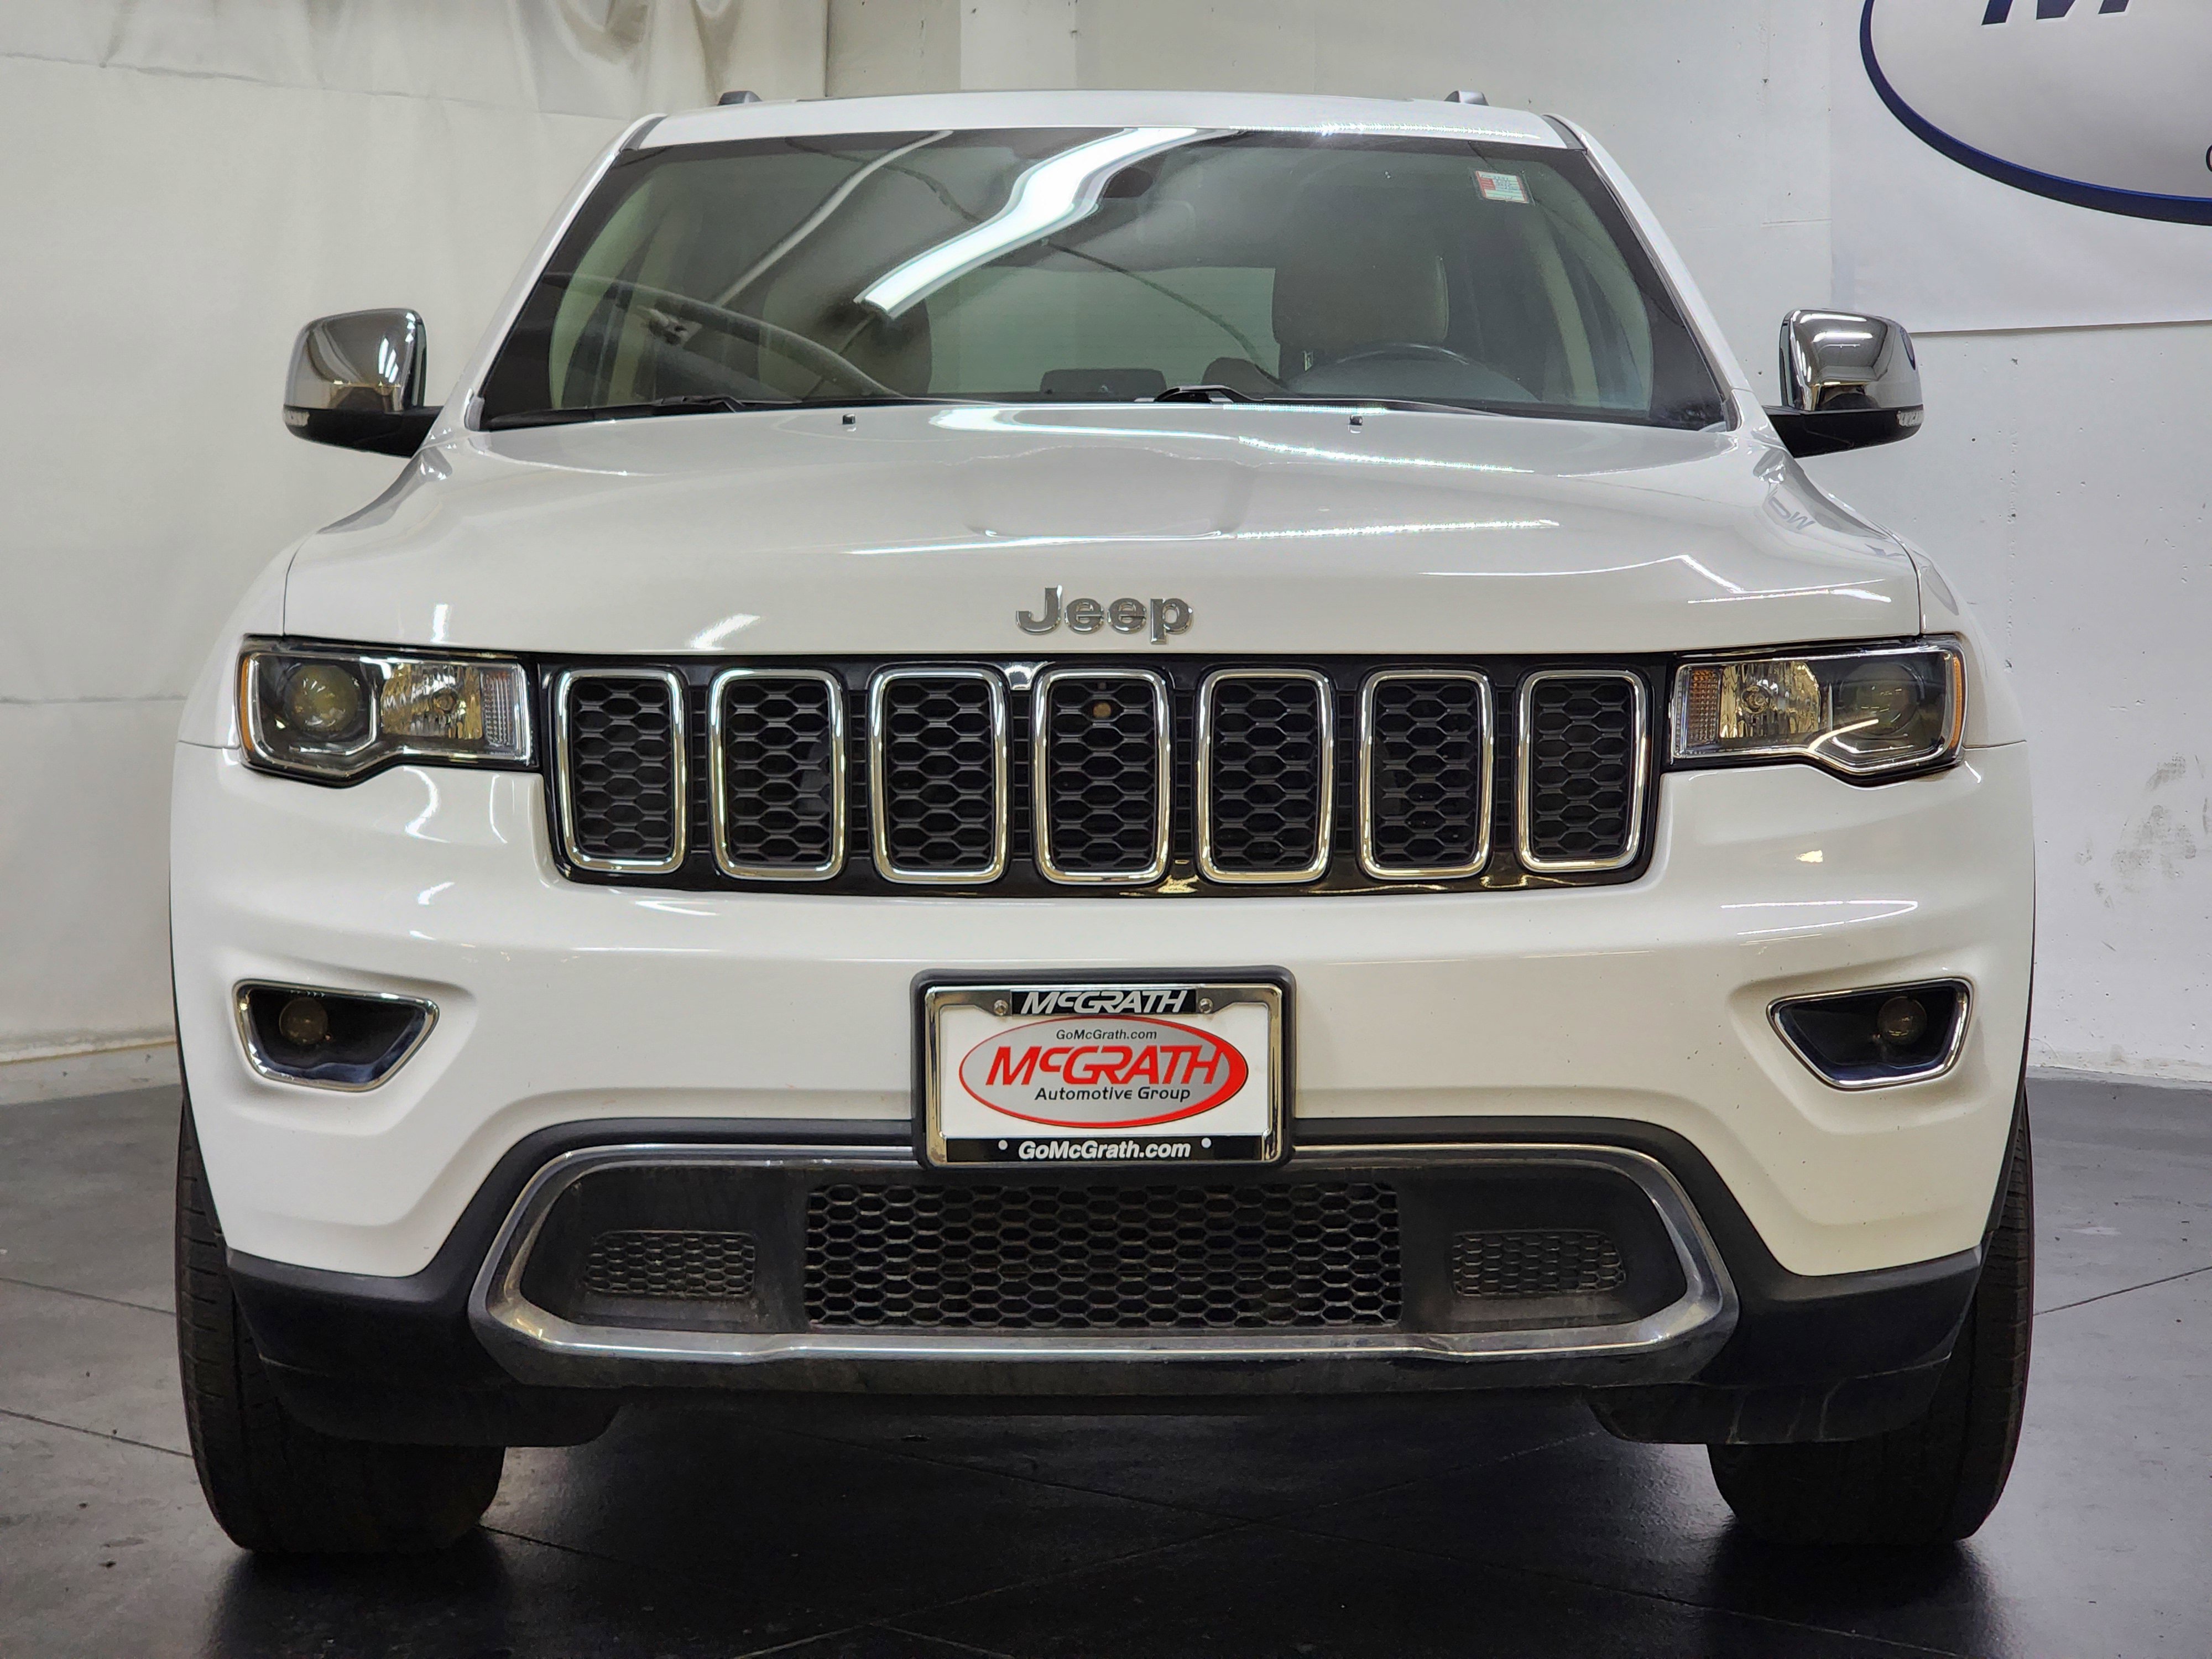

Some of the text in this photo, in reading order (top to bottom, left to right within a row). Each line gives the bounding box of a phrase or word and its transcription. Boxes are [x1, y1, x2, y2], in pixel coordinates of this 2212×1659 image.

[1016, 585, 1193, 644] Jeep
[1020, 990, 1187, 1014] McGRATH
[1056, 1029, 1157, 1040] GoMcGrath.com
[985, 1045, 1223, 1085] McGRATH
[1035, 1087, 1191, 1102] Automotive Group
[1019, 1140, 1191, 1159] GoMcGrath.com
